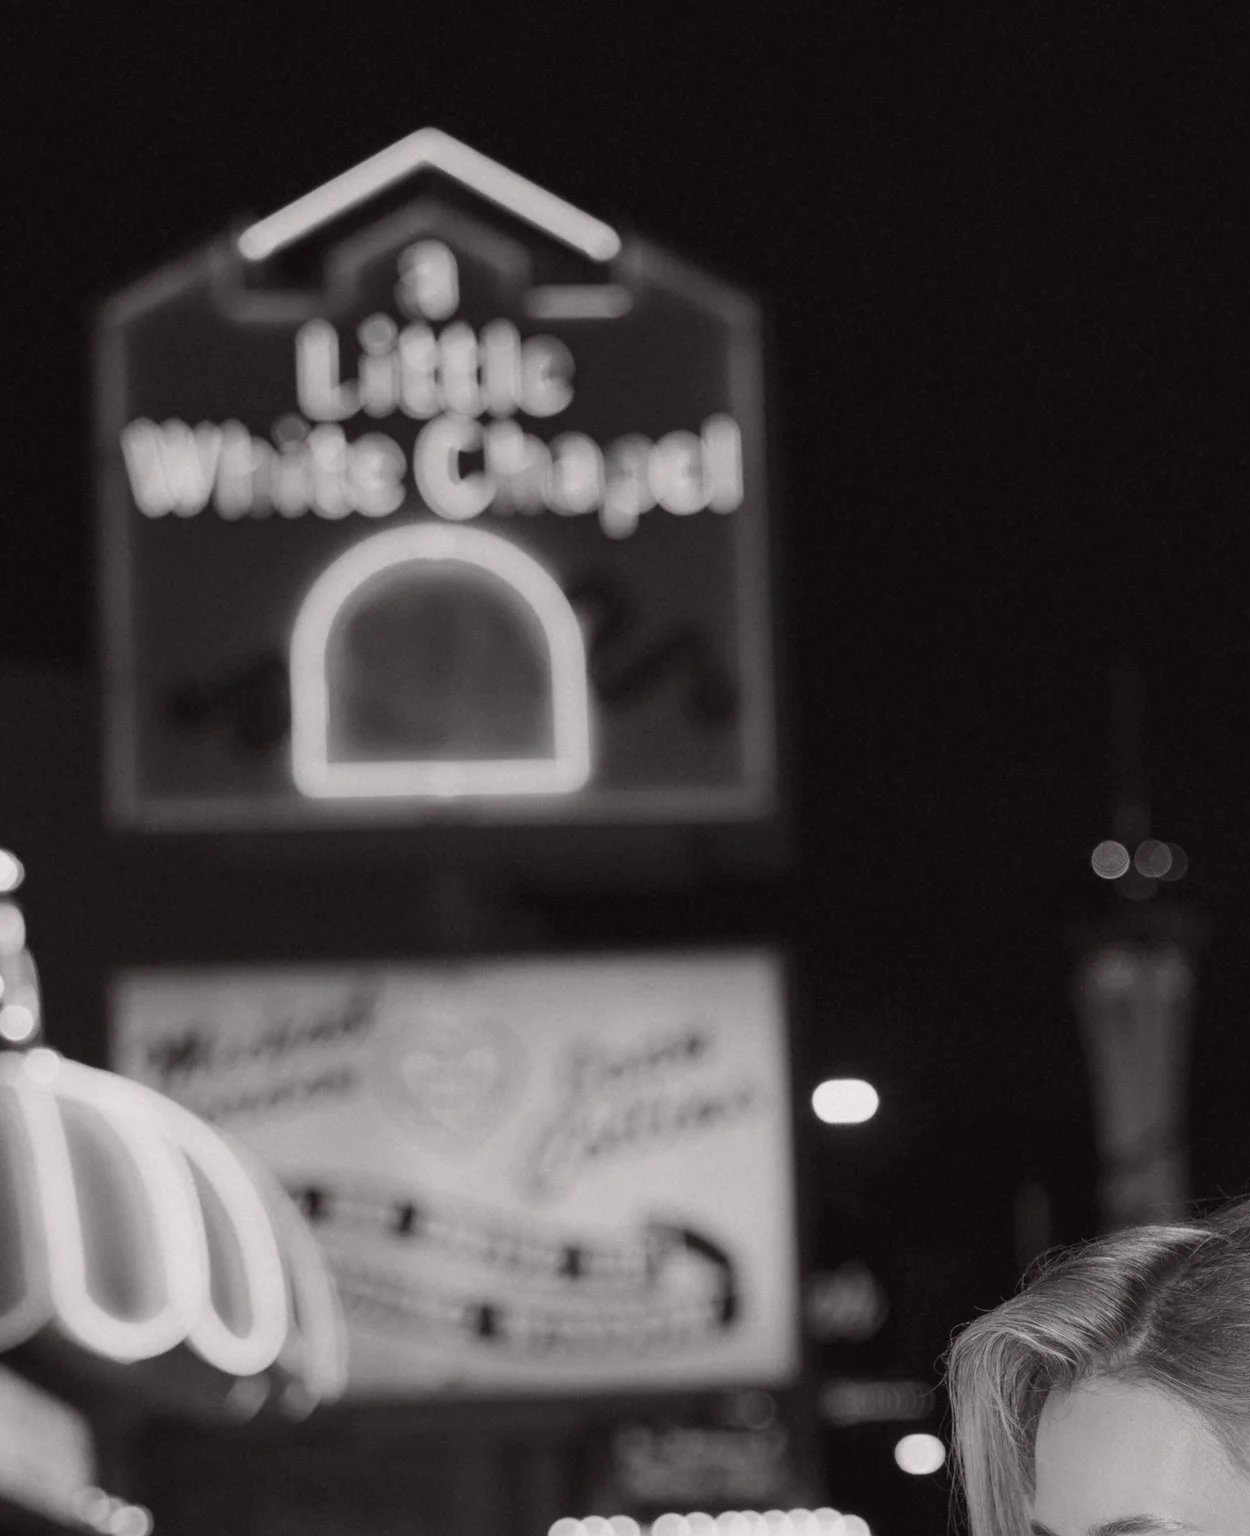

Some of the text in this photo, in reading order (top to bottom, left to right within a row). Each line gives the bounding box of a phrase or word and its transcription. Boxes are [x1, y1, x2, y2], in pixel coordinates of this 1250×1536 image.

[296, 313, 575, 420] Little
[121, 413, 743, 540] White Chapel
